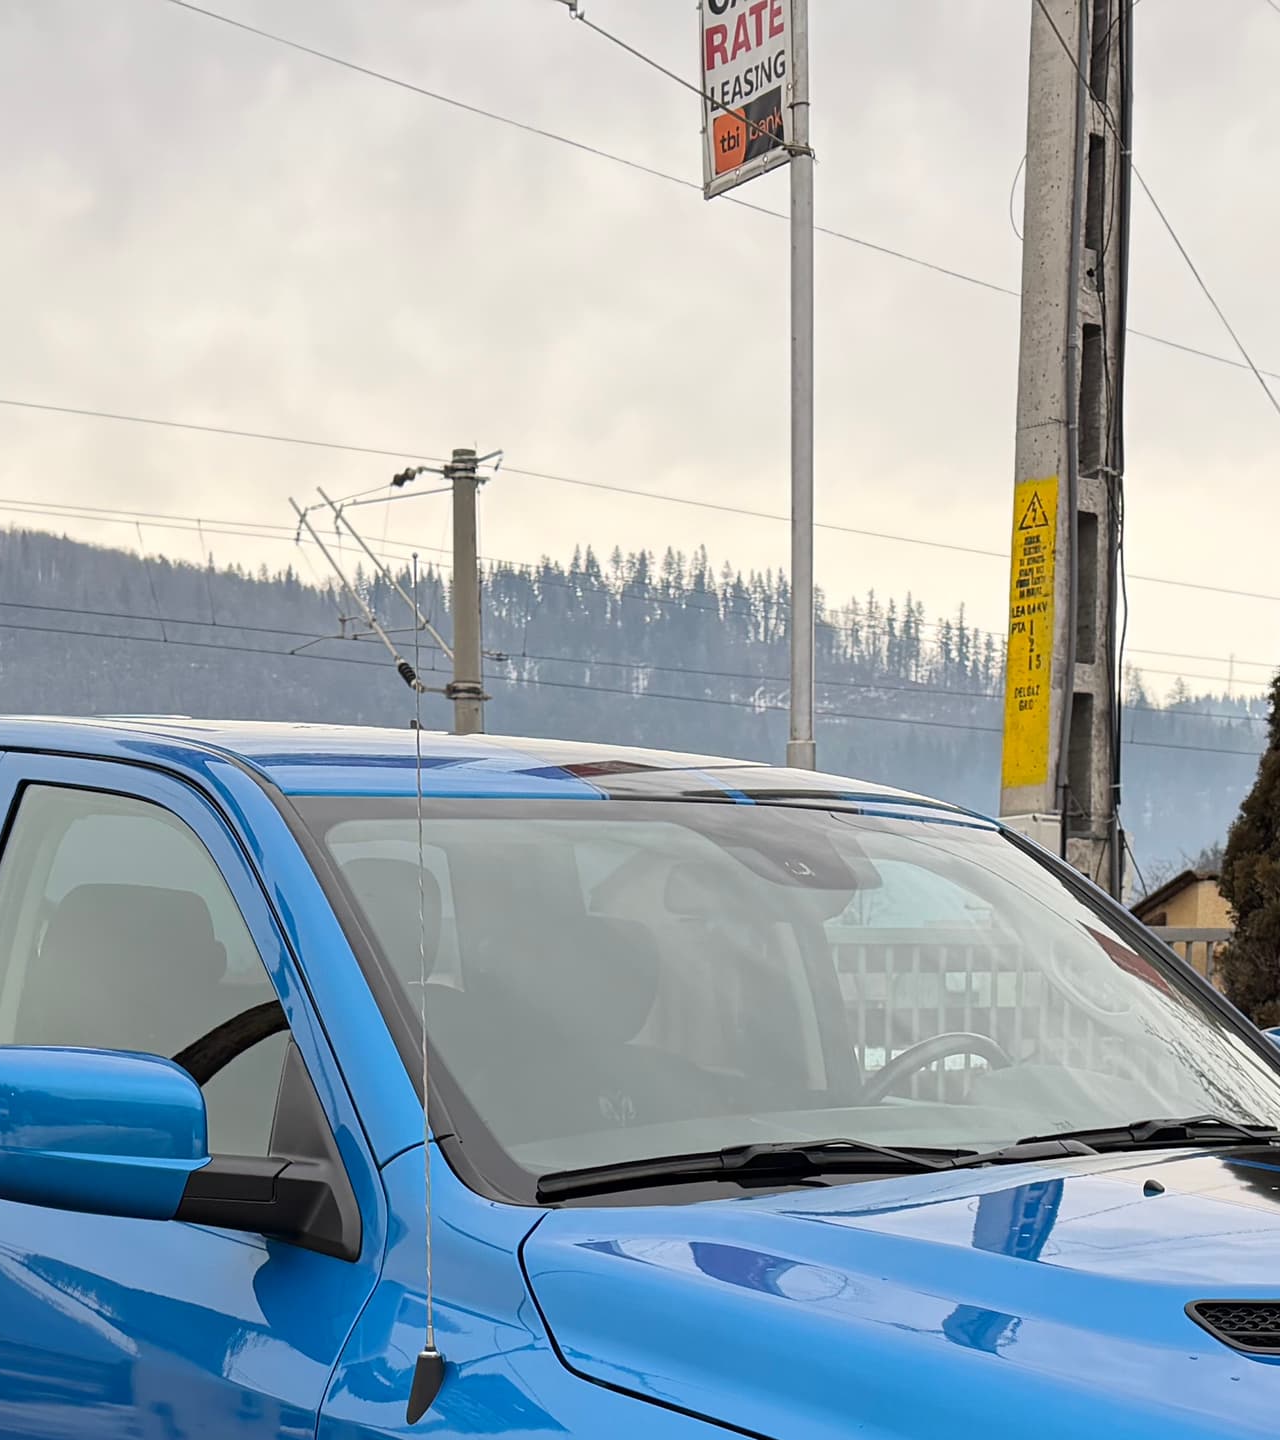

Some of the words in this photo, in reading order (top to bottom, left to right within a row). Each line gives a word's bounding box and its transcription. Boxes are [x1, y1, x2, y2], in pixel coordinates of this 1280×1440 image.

[705, 0, 784, 71] RATE
[710, 49, 786, 113] LEASING
[720, 125, 740, 153] tbi
[749, 105, 783, 141] bank
